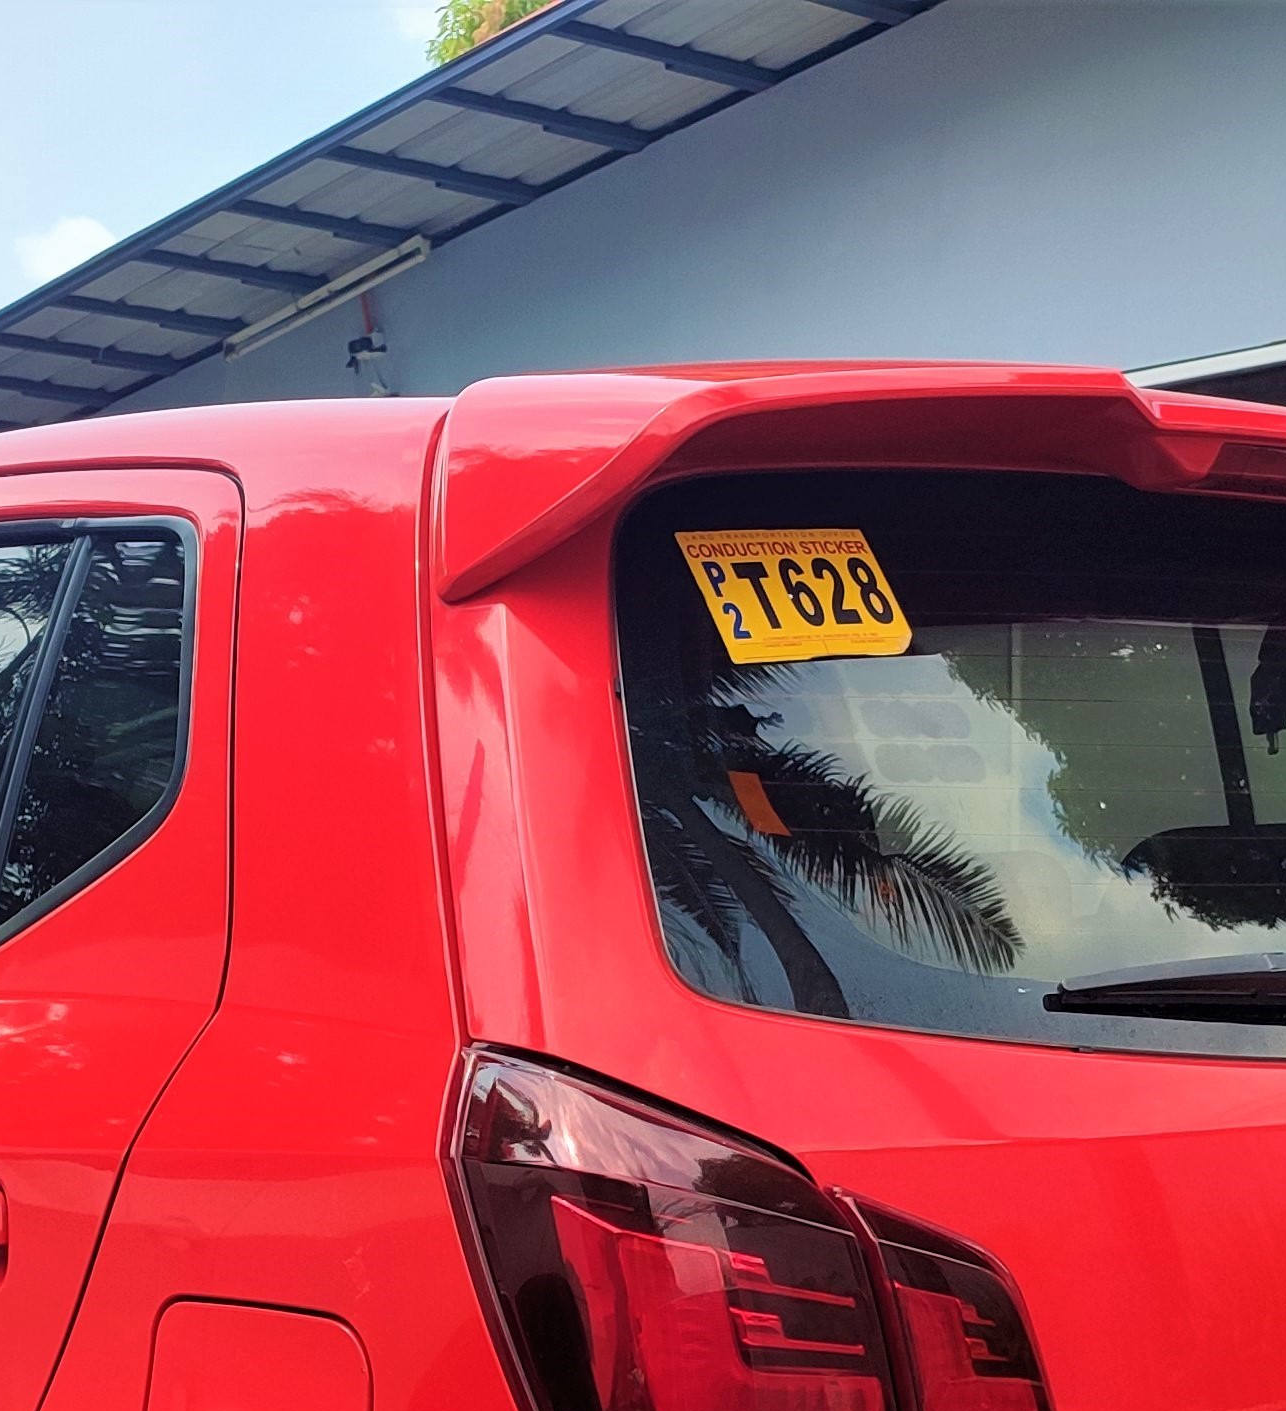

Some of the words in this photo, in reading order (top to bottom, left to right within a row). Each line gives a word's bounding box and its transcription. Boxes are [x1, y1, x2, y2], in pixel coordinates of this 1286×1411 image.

[686, 541, 798, 558] CONDUCTION
[798, 540, 868, 555] STICKER
[730, 557, 894, 629] T628
